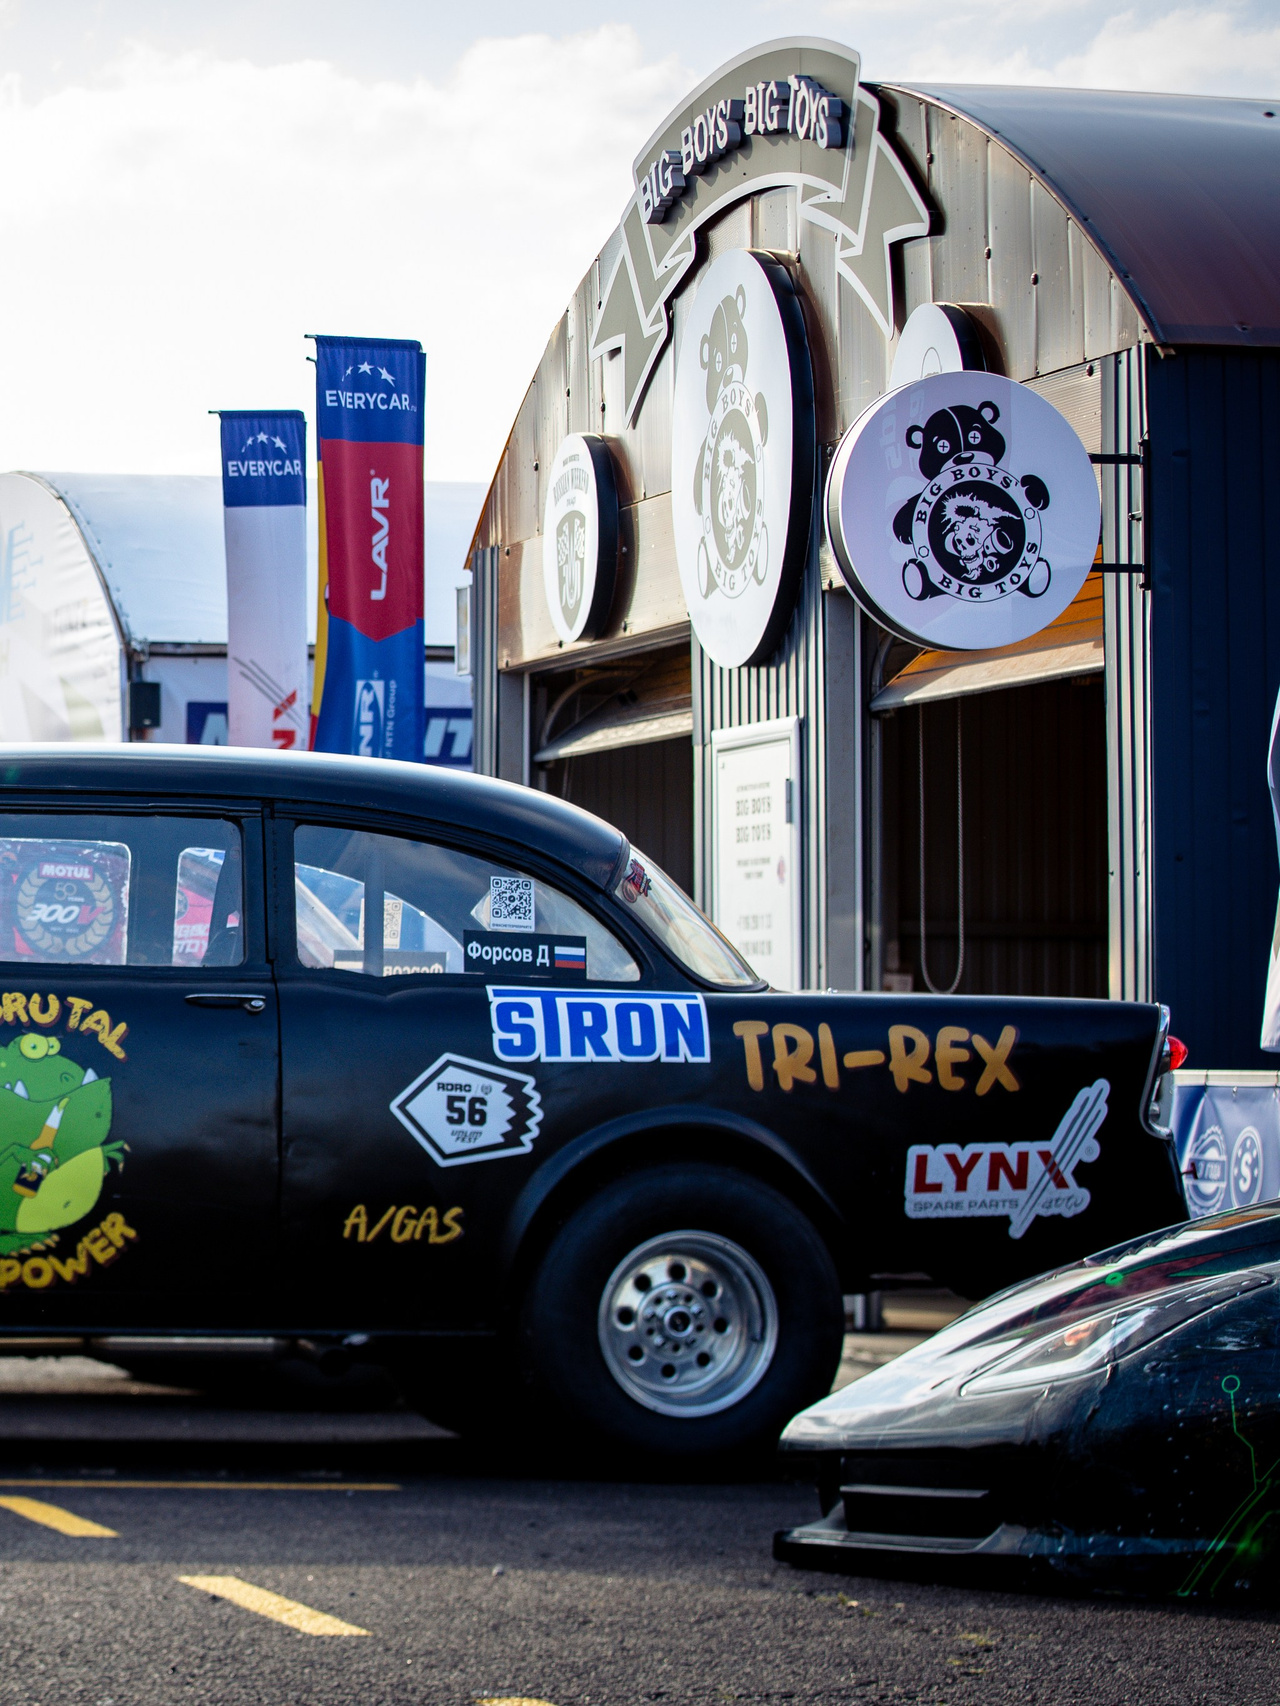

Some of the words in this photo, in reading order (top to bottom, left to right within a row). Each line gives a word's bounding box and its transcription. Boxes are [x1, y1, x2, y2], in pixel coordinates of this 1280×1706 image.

[640, 150, 678, 224] BIG
[744, 80, 786, 135] BIG
[787, 74, 836, 149] TOYS
[227, 460, 302, 477] EVERYCAR
[915, 482, 943, 524] BIG
[371, 477, 389, 600] LAVR
[938, 574, 982, 598] BIG
[995, 541, 1038, 594] TOYS
[41, 864, 91, 879] MOTUL
[54, 882, 77, 900] 50
[26, 903, 106, 924] 300V
[467, 941, 533, 964] Форсов
[536, 945, 550, 967] Д
[732, 1020, 1020, 1096] TRI-REX
[446, 1095, 487, 1126] 56
[913, 1150, 1070, 1194] LYNX
[913, 1200, 965, 1212] SPARE
[969, 1198, 1020, 1210] PARTS
[343, 1204, 464, 1244] A/GAS
